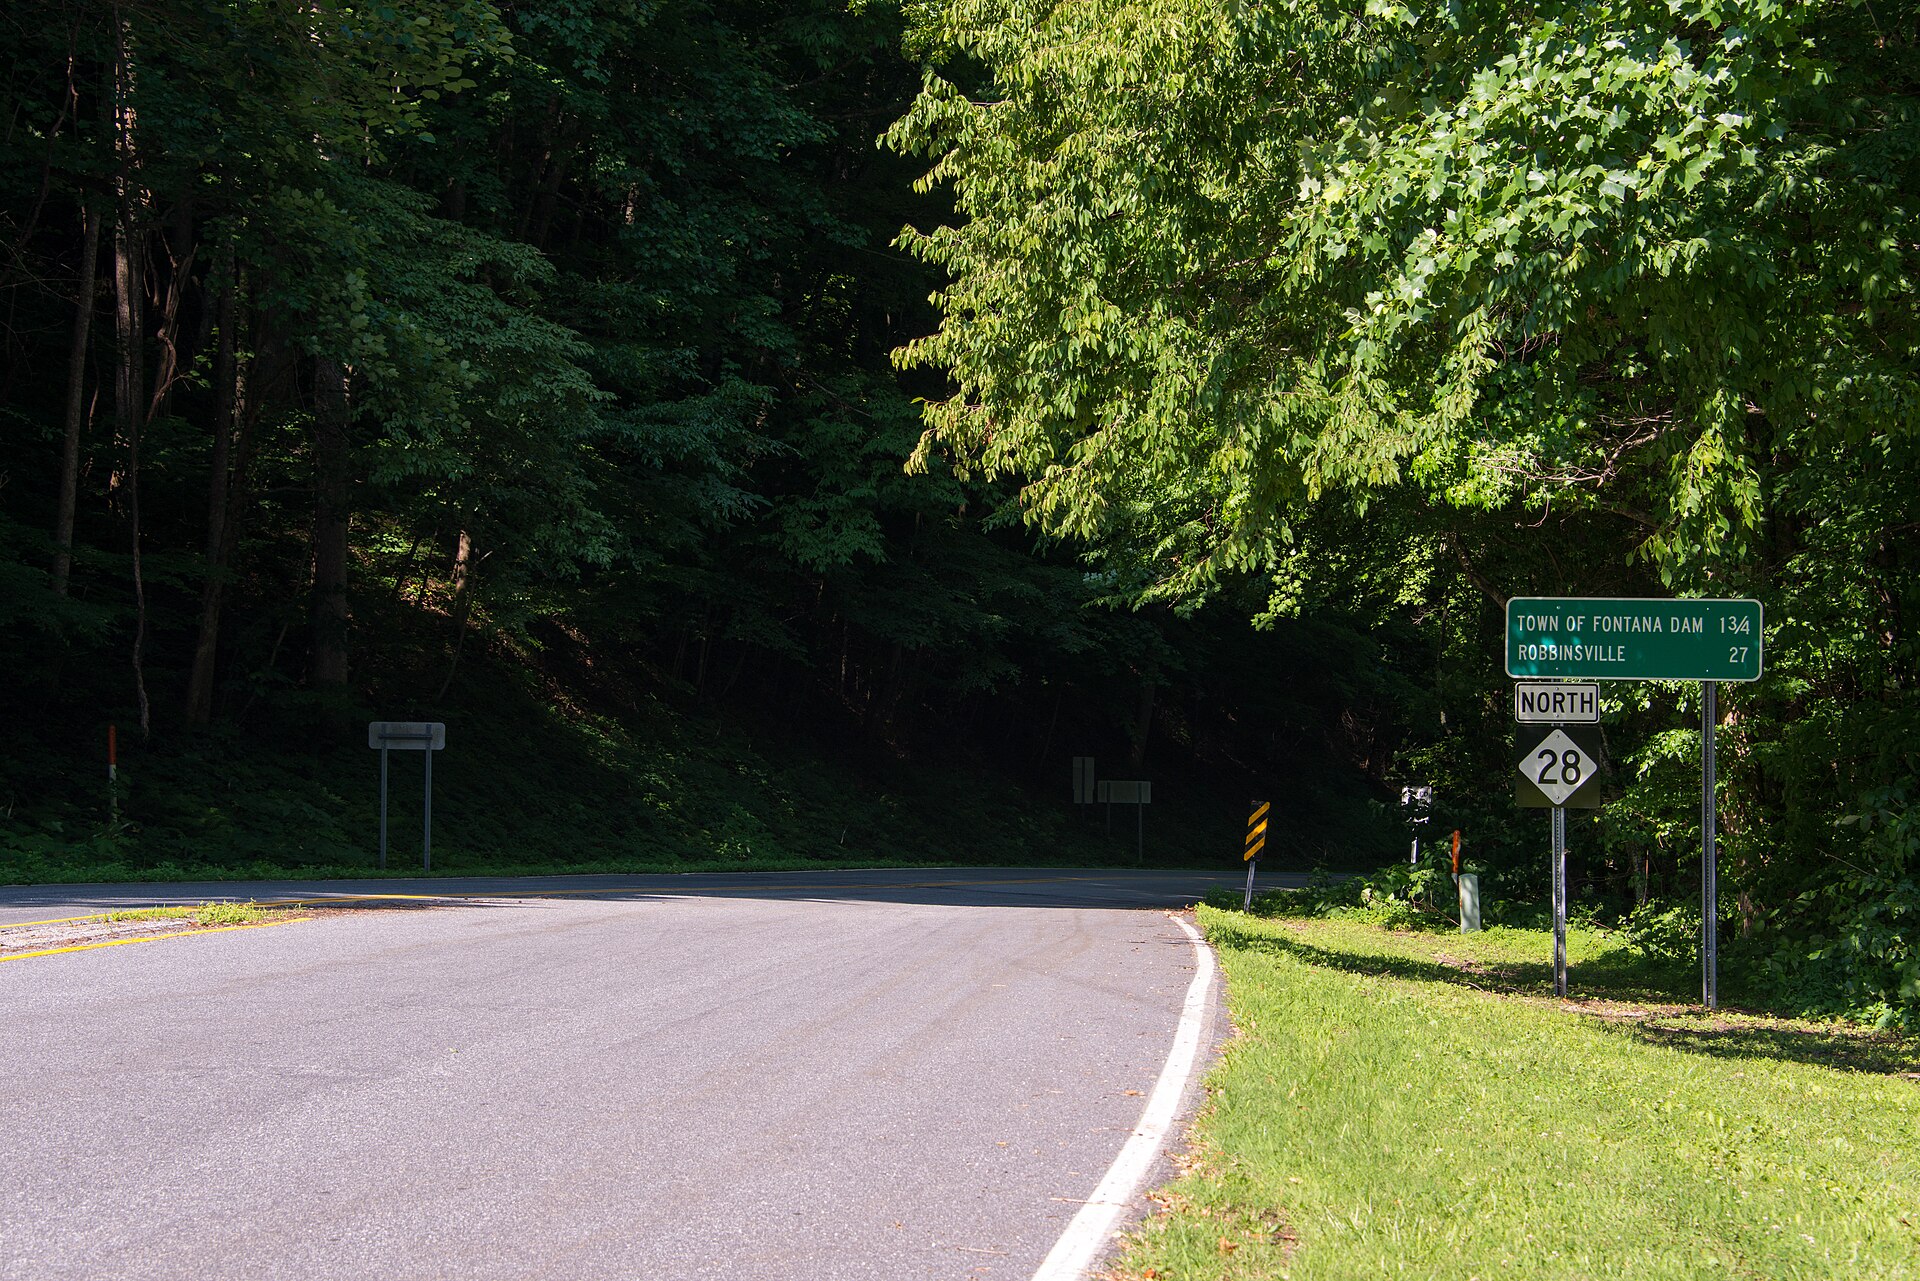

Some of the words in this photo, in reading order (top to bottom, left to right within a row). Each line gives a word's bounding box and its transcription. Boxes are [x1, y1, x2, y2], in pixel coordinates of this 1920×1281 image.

[1517, 615, 1559, 631] TOWN
[1566, 615, 1586, 632] OF
[1593, 616, 1663, 633] FONTANA
[1670, 616, 1703, 633] DAM
[1518, 644, 1626, 661] ROBBINSVILLE
[1729, 646, 1749, 663] 27
[1521, 692, 1594, 713] NORTH
[1537, 748, 1581, 786] 28
